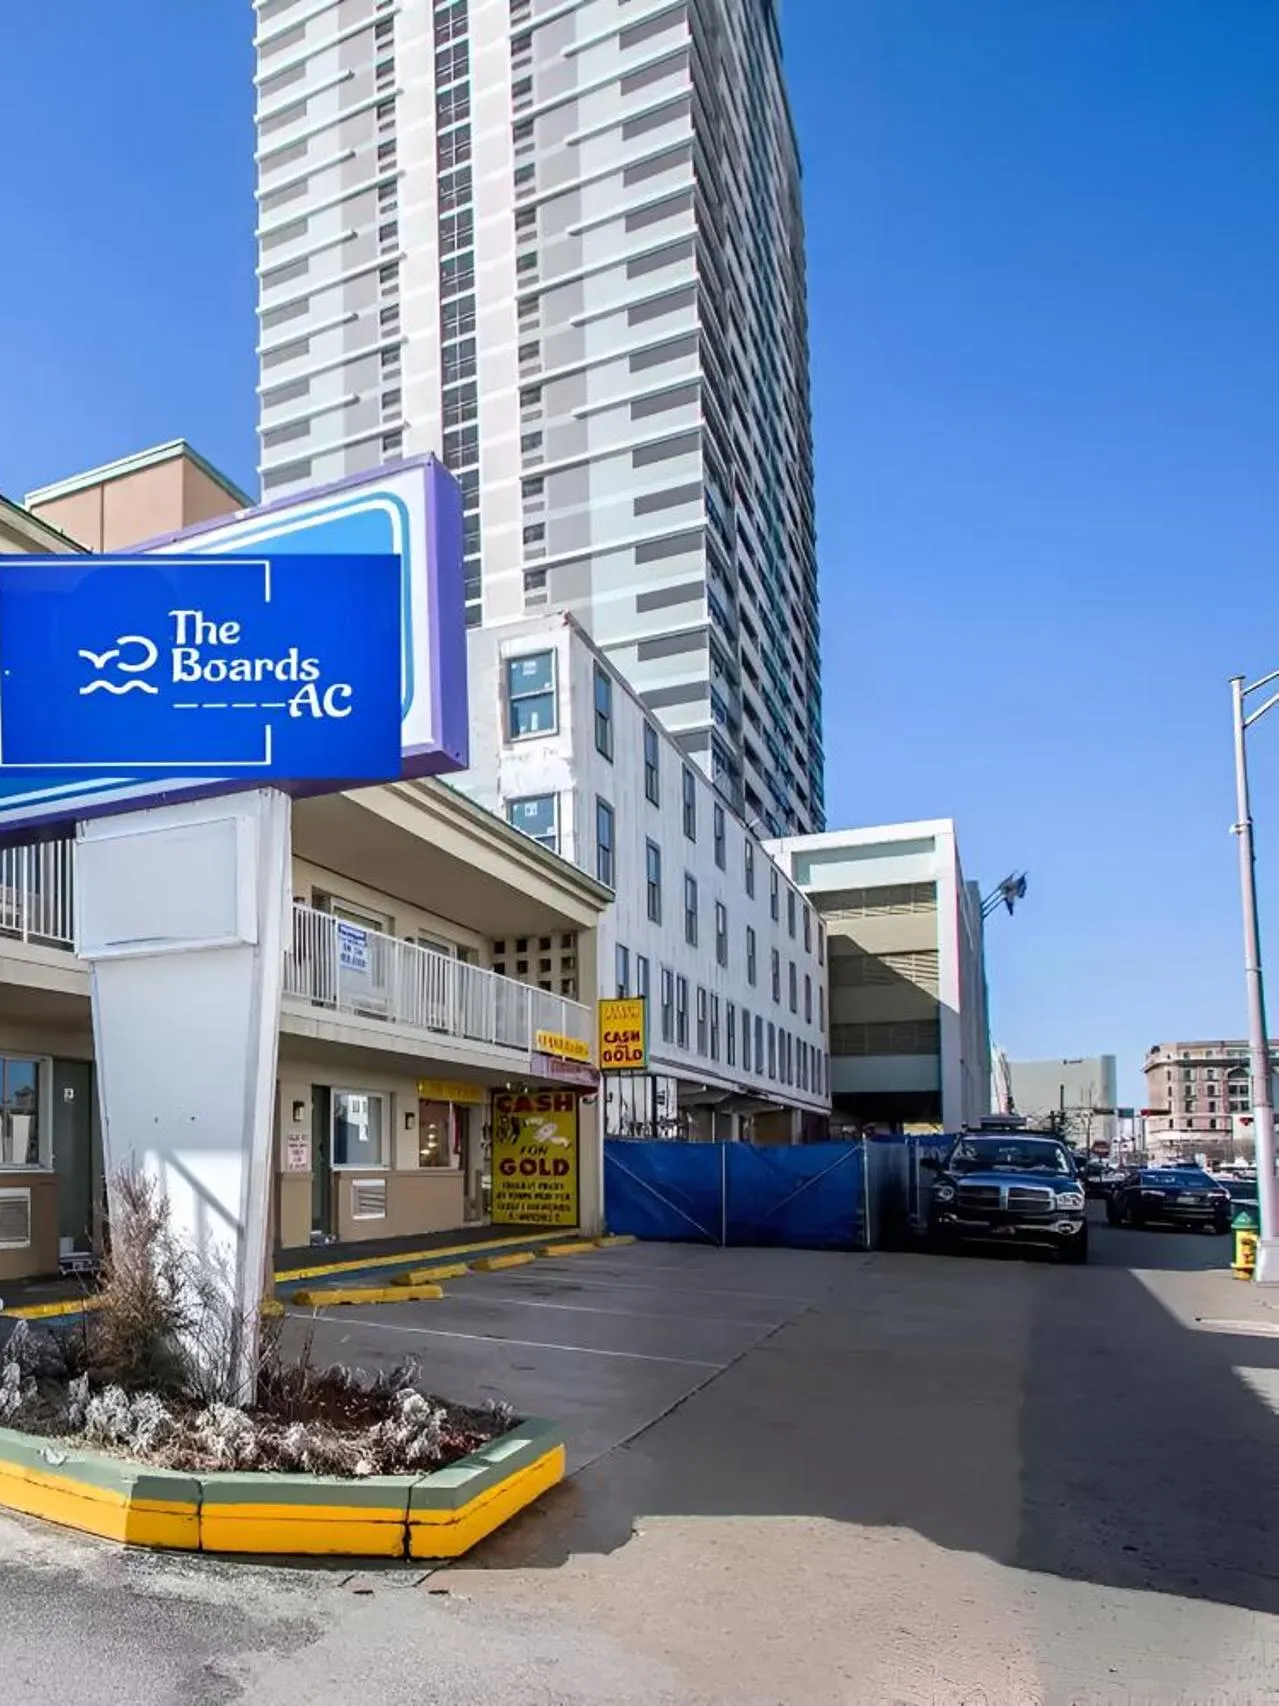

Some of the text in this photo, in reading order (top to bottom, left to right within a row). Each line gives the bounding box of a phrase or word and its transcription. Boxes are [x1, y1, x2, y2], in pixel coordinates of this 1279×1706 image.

[169, 610, 240, 645] The
[172, 647, 320, 682] Boards
[288, 683, 352, 718] AC
[603, 1031, 640, 1044] CASH
[603, 1048, 643, 1062] GOLD
[496, 1094, 573, 1113] CASH
[499, 1158, 570, 1176] GOLD
